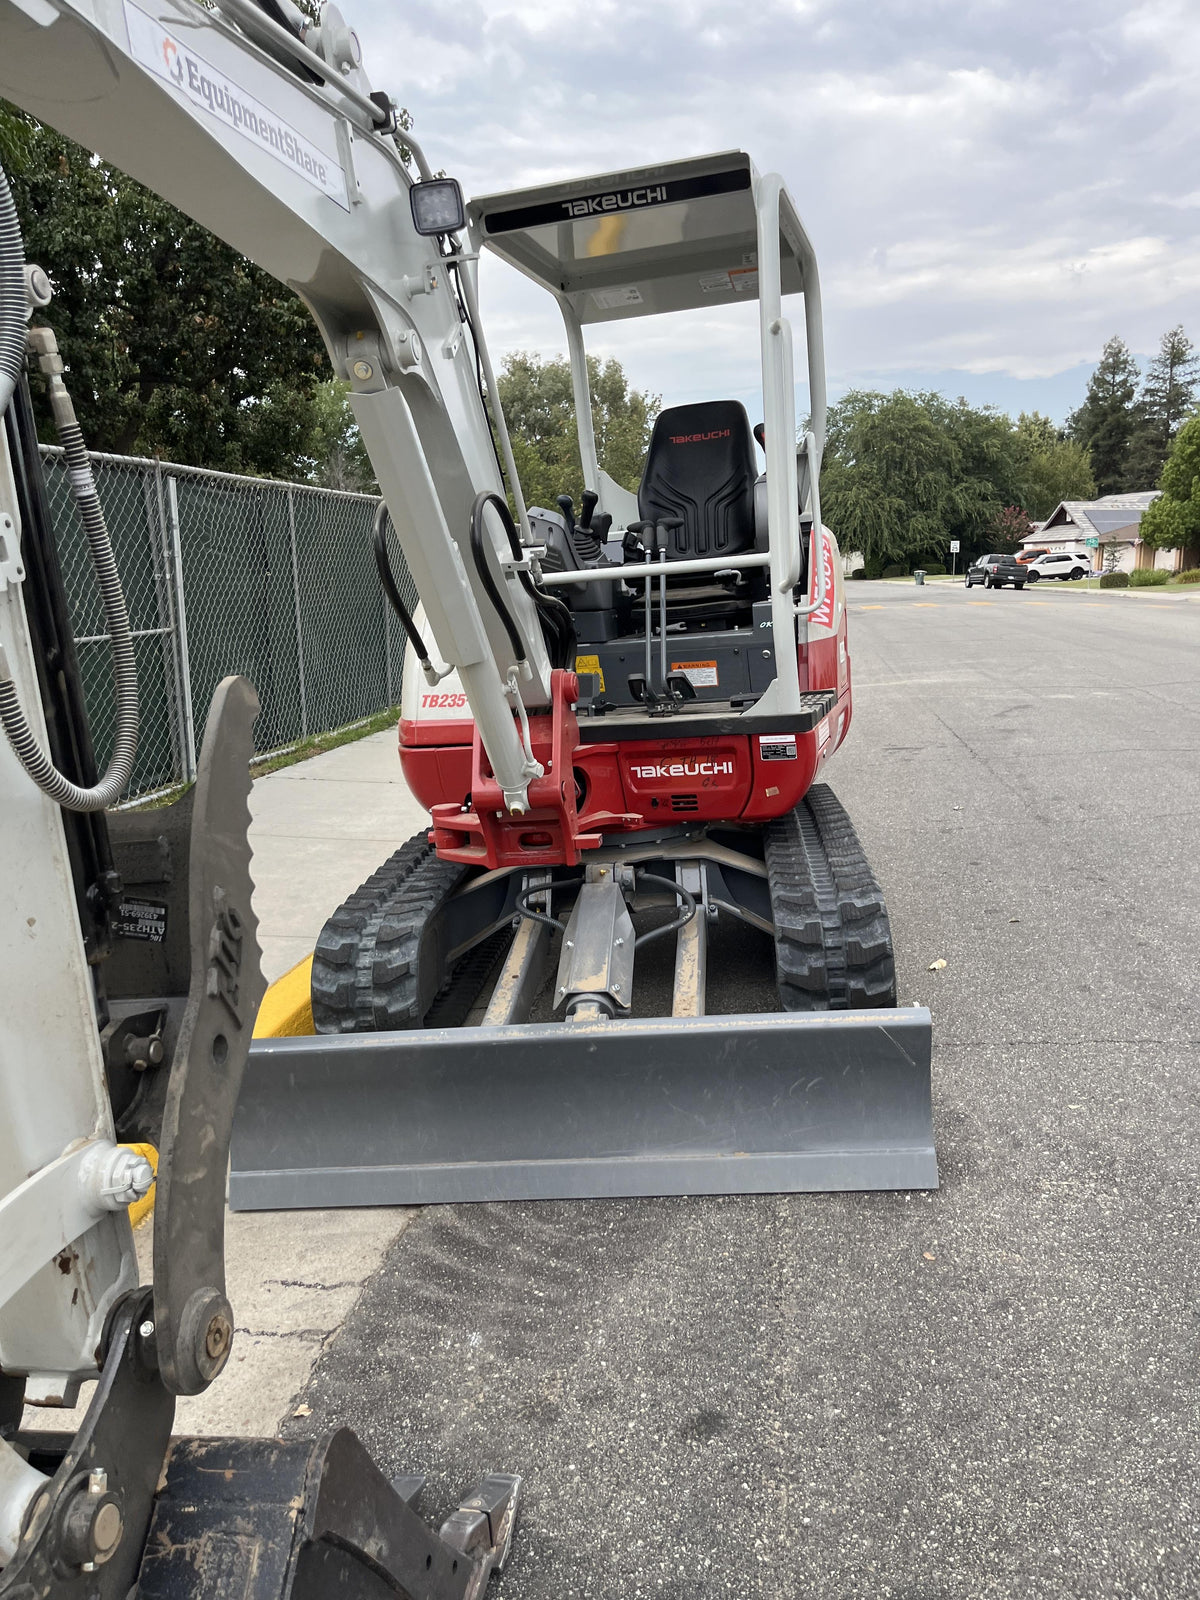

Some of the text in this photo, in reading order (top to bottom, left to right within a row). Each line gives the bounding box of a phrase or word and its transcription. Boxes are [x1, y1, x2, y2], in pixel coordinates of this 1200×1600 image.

[186, 57, 327, 185] EquipmentShare
[562, 186, 667, 216] TAKEUCHI
[669, 429, 731, 444] TAKEUCHI
[630, 761, 732, 778] TAKEUCHI
[111, 921, 166, 935] ATH235-2
